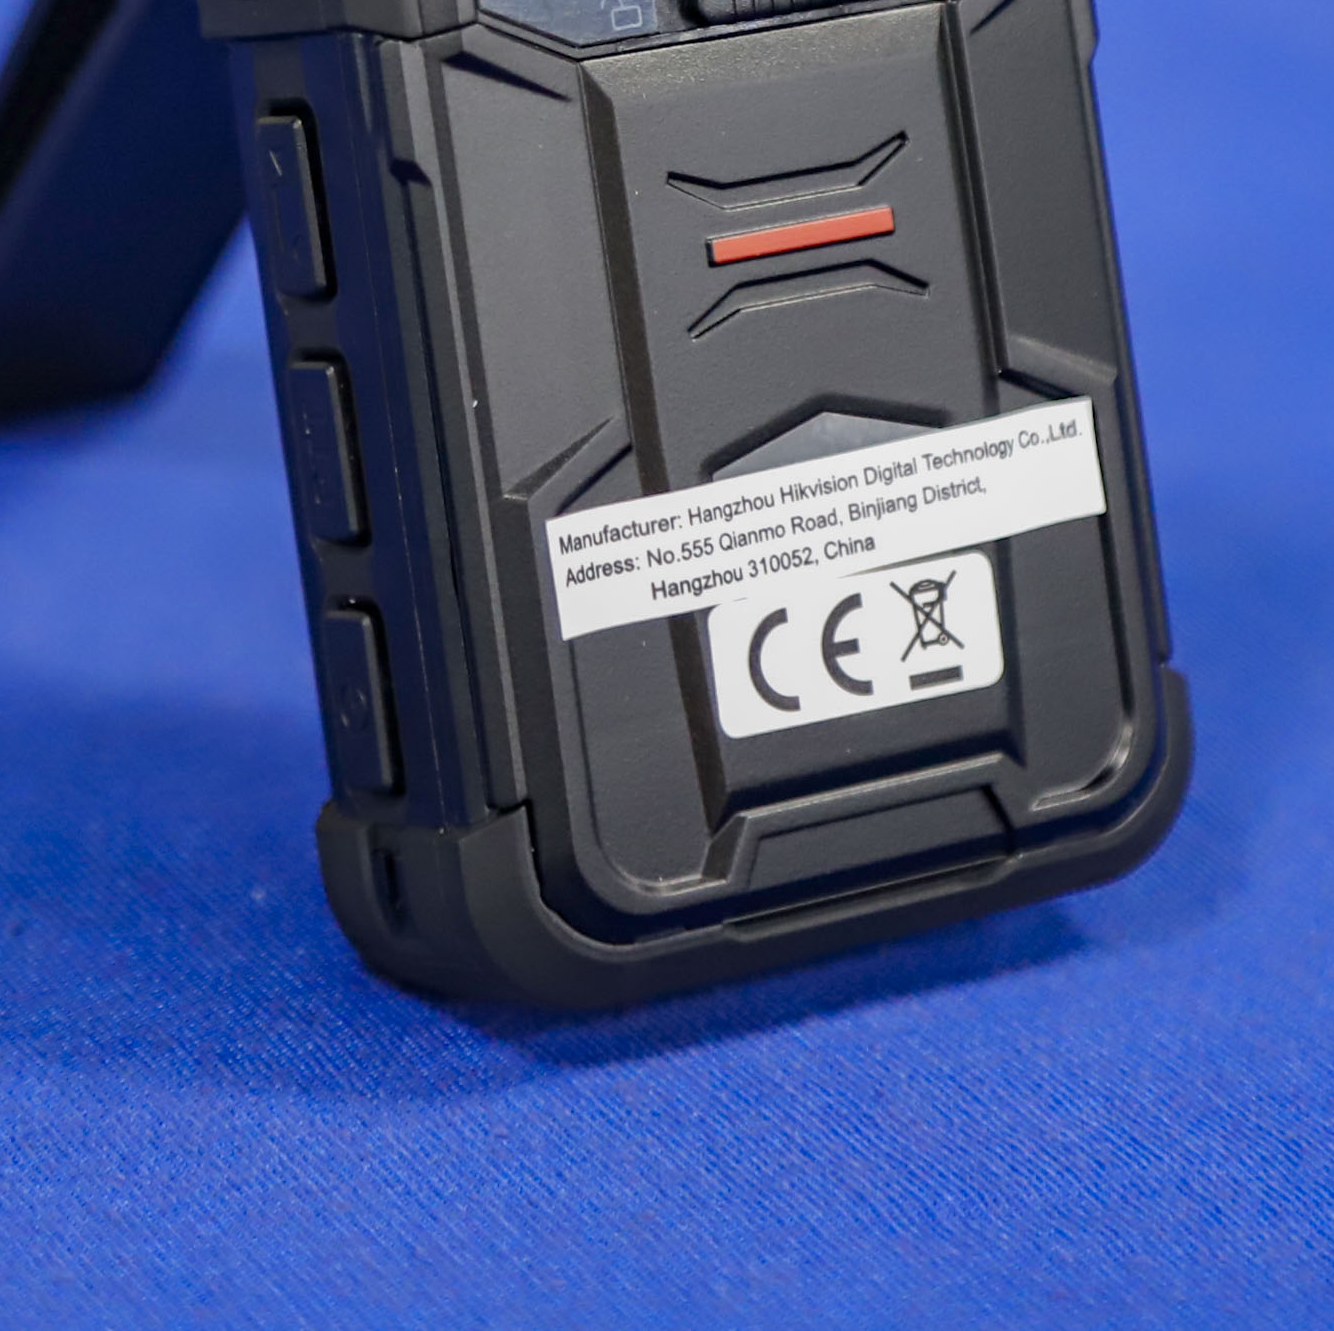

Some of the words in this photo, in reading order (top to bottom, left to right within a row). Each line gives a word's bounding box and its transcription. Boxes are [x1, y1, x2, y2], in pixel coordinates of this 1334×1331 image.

[559, 515, 683, 555] Manufacturer:
[687, 493, 775, 526] Hangzhou
[779, 474, 859, 503] Hikvision
[863, 458, 918, 486] Digital
[922, 439, 1015, 471] Technology
[1017, 420, 1083, 448] Co.,Ltd.
[565, 556, 641, 587] Address:
[646, 537, 714, 568] No.555
[719, 523, 786, 552] Qianmo
[790, 507, 844, 535] Road,
[848, 492, 918, 522] Binjiang
[923, 475, 987, 505] District,
[651, 567, 744, 600] Hangzhou
[748, 548, 820, 578] 310052,
[824, 534, 876, 561] China
[748, 592, 874, 712] CE
